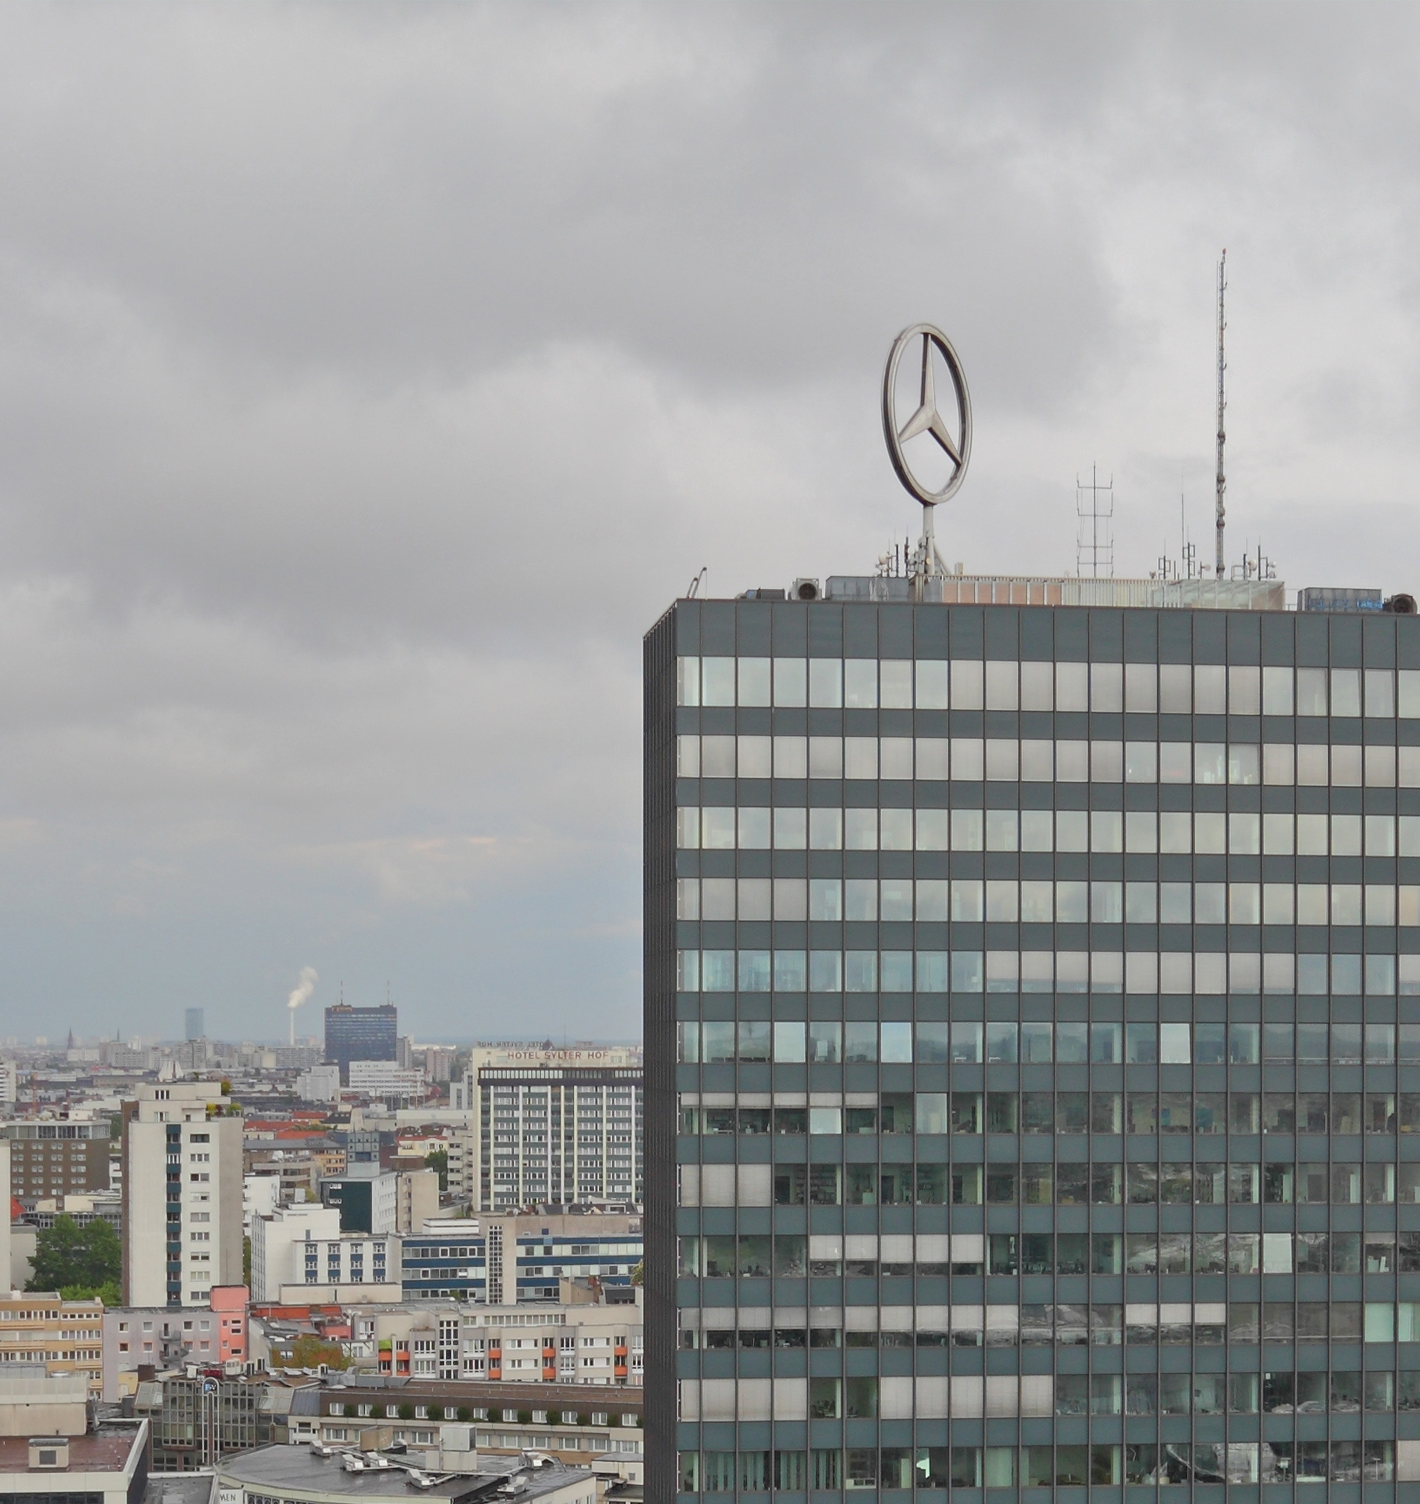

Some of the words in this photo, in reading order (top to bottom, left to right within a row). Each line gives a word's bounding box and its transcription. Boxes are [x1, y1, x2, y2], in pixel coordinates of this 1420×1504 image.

[508, 1051, 541, 1060] HOTEL
[544, 1051, 582, 1060] SYLTER
[587, 1051, 609, 1060] HOF
